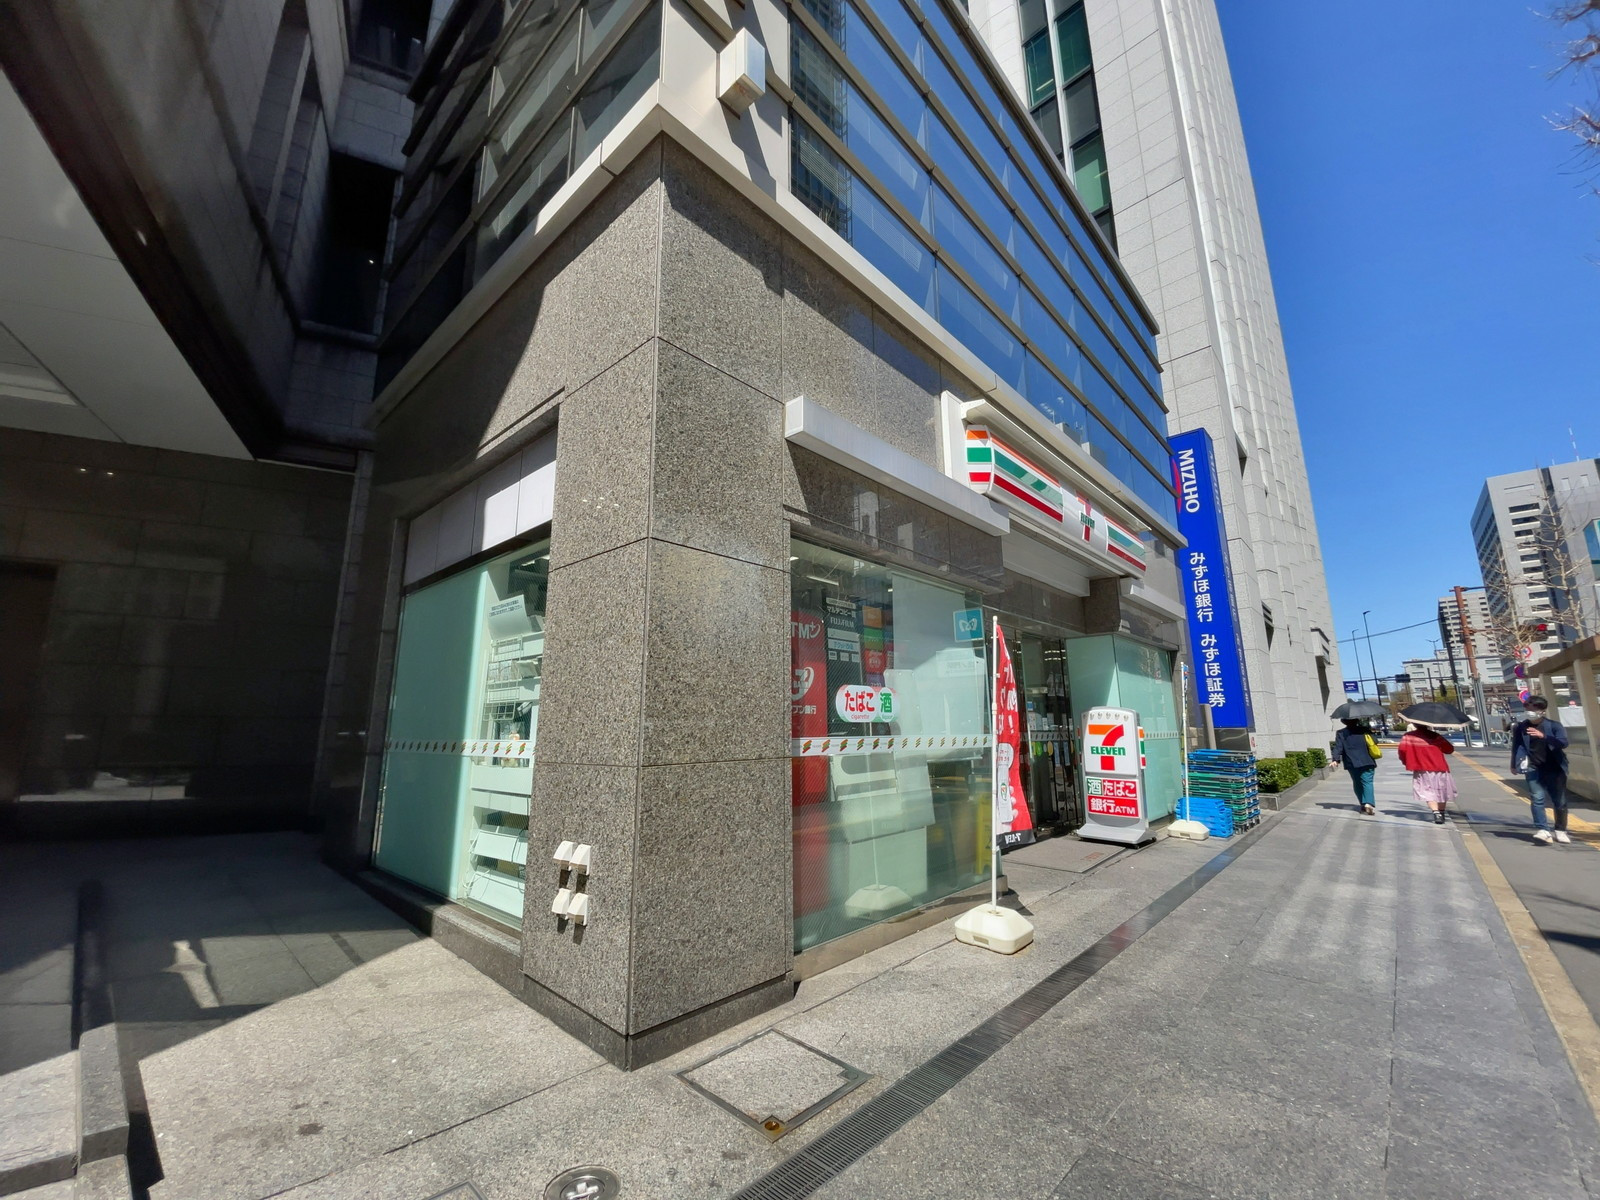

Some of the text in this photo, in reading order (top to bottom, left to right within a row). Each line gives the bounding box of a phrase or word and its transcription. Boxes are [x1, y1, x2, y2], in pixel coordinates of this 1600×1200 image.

[1178, 448, 1200, 513] MIZUHO
[1189, 551, 1214, 623] みずほ銀行
[1200, 633, 1226, 708] みずほ証券
[844, 690, 876, 712] たばこ
[880, 692, 893, 713] 酒
[1087, 723, 1125, 771] 7
[1087, 779, 1102, 795] 酒
[1103, 780, 1137, 798] たばこ
